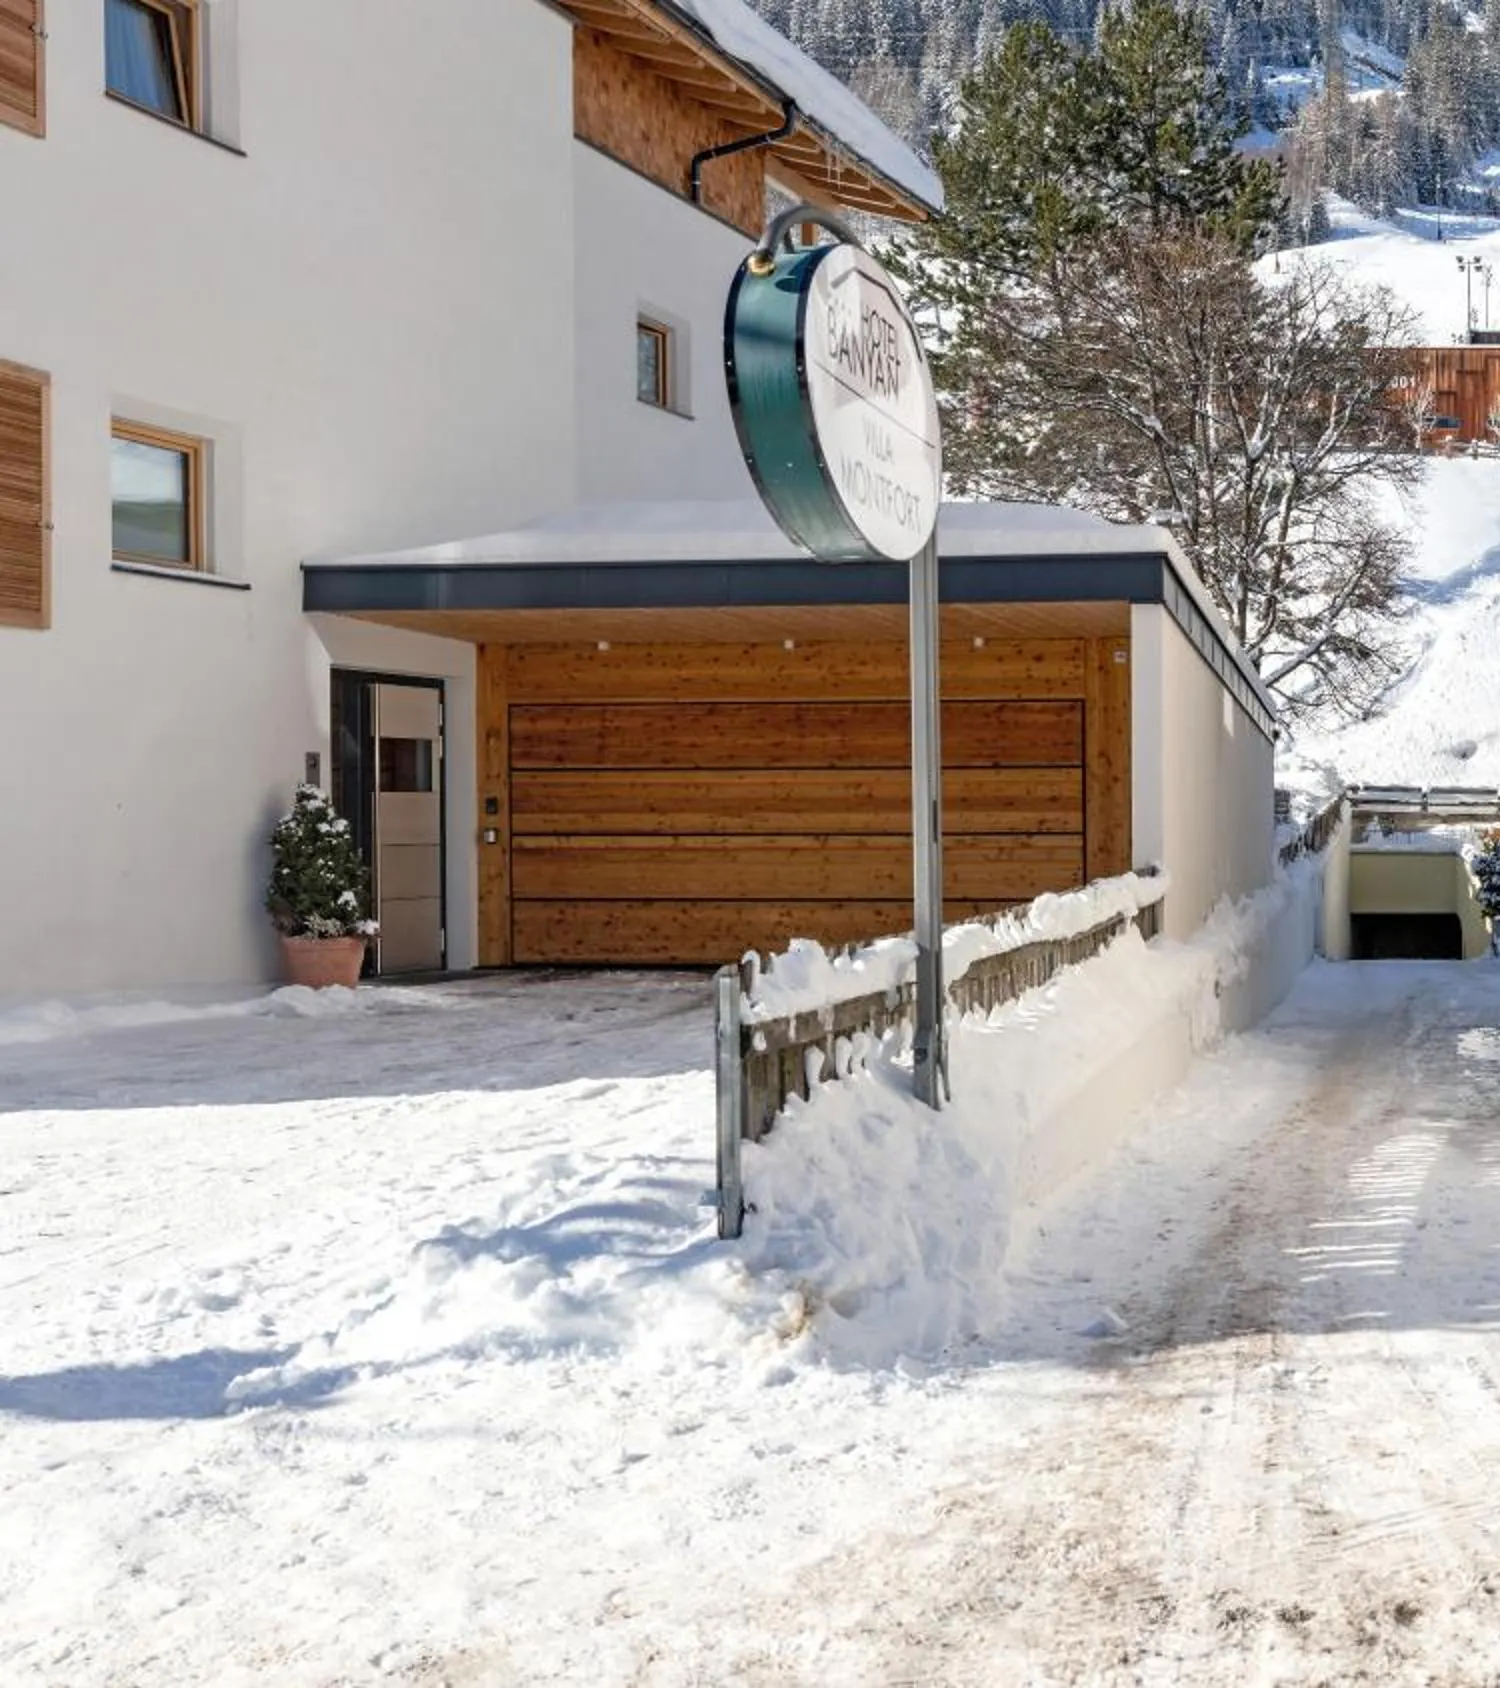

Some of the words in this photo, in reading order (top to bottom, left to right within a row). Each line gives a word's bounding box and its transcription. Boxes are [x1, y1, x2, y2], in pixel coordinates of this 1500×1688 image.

[827, 304, 900, 401] BANYAN
[860, 304, 901, 367] HOTEL
[861, 412, 895, 465] VILLA
[840, 450, 922, 535] MONTFORT
